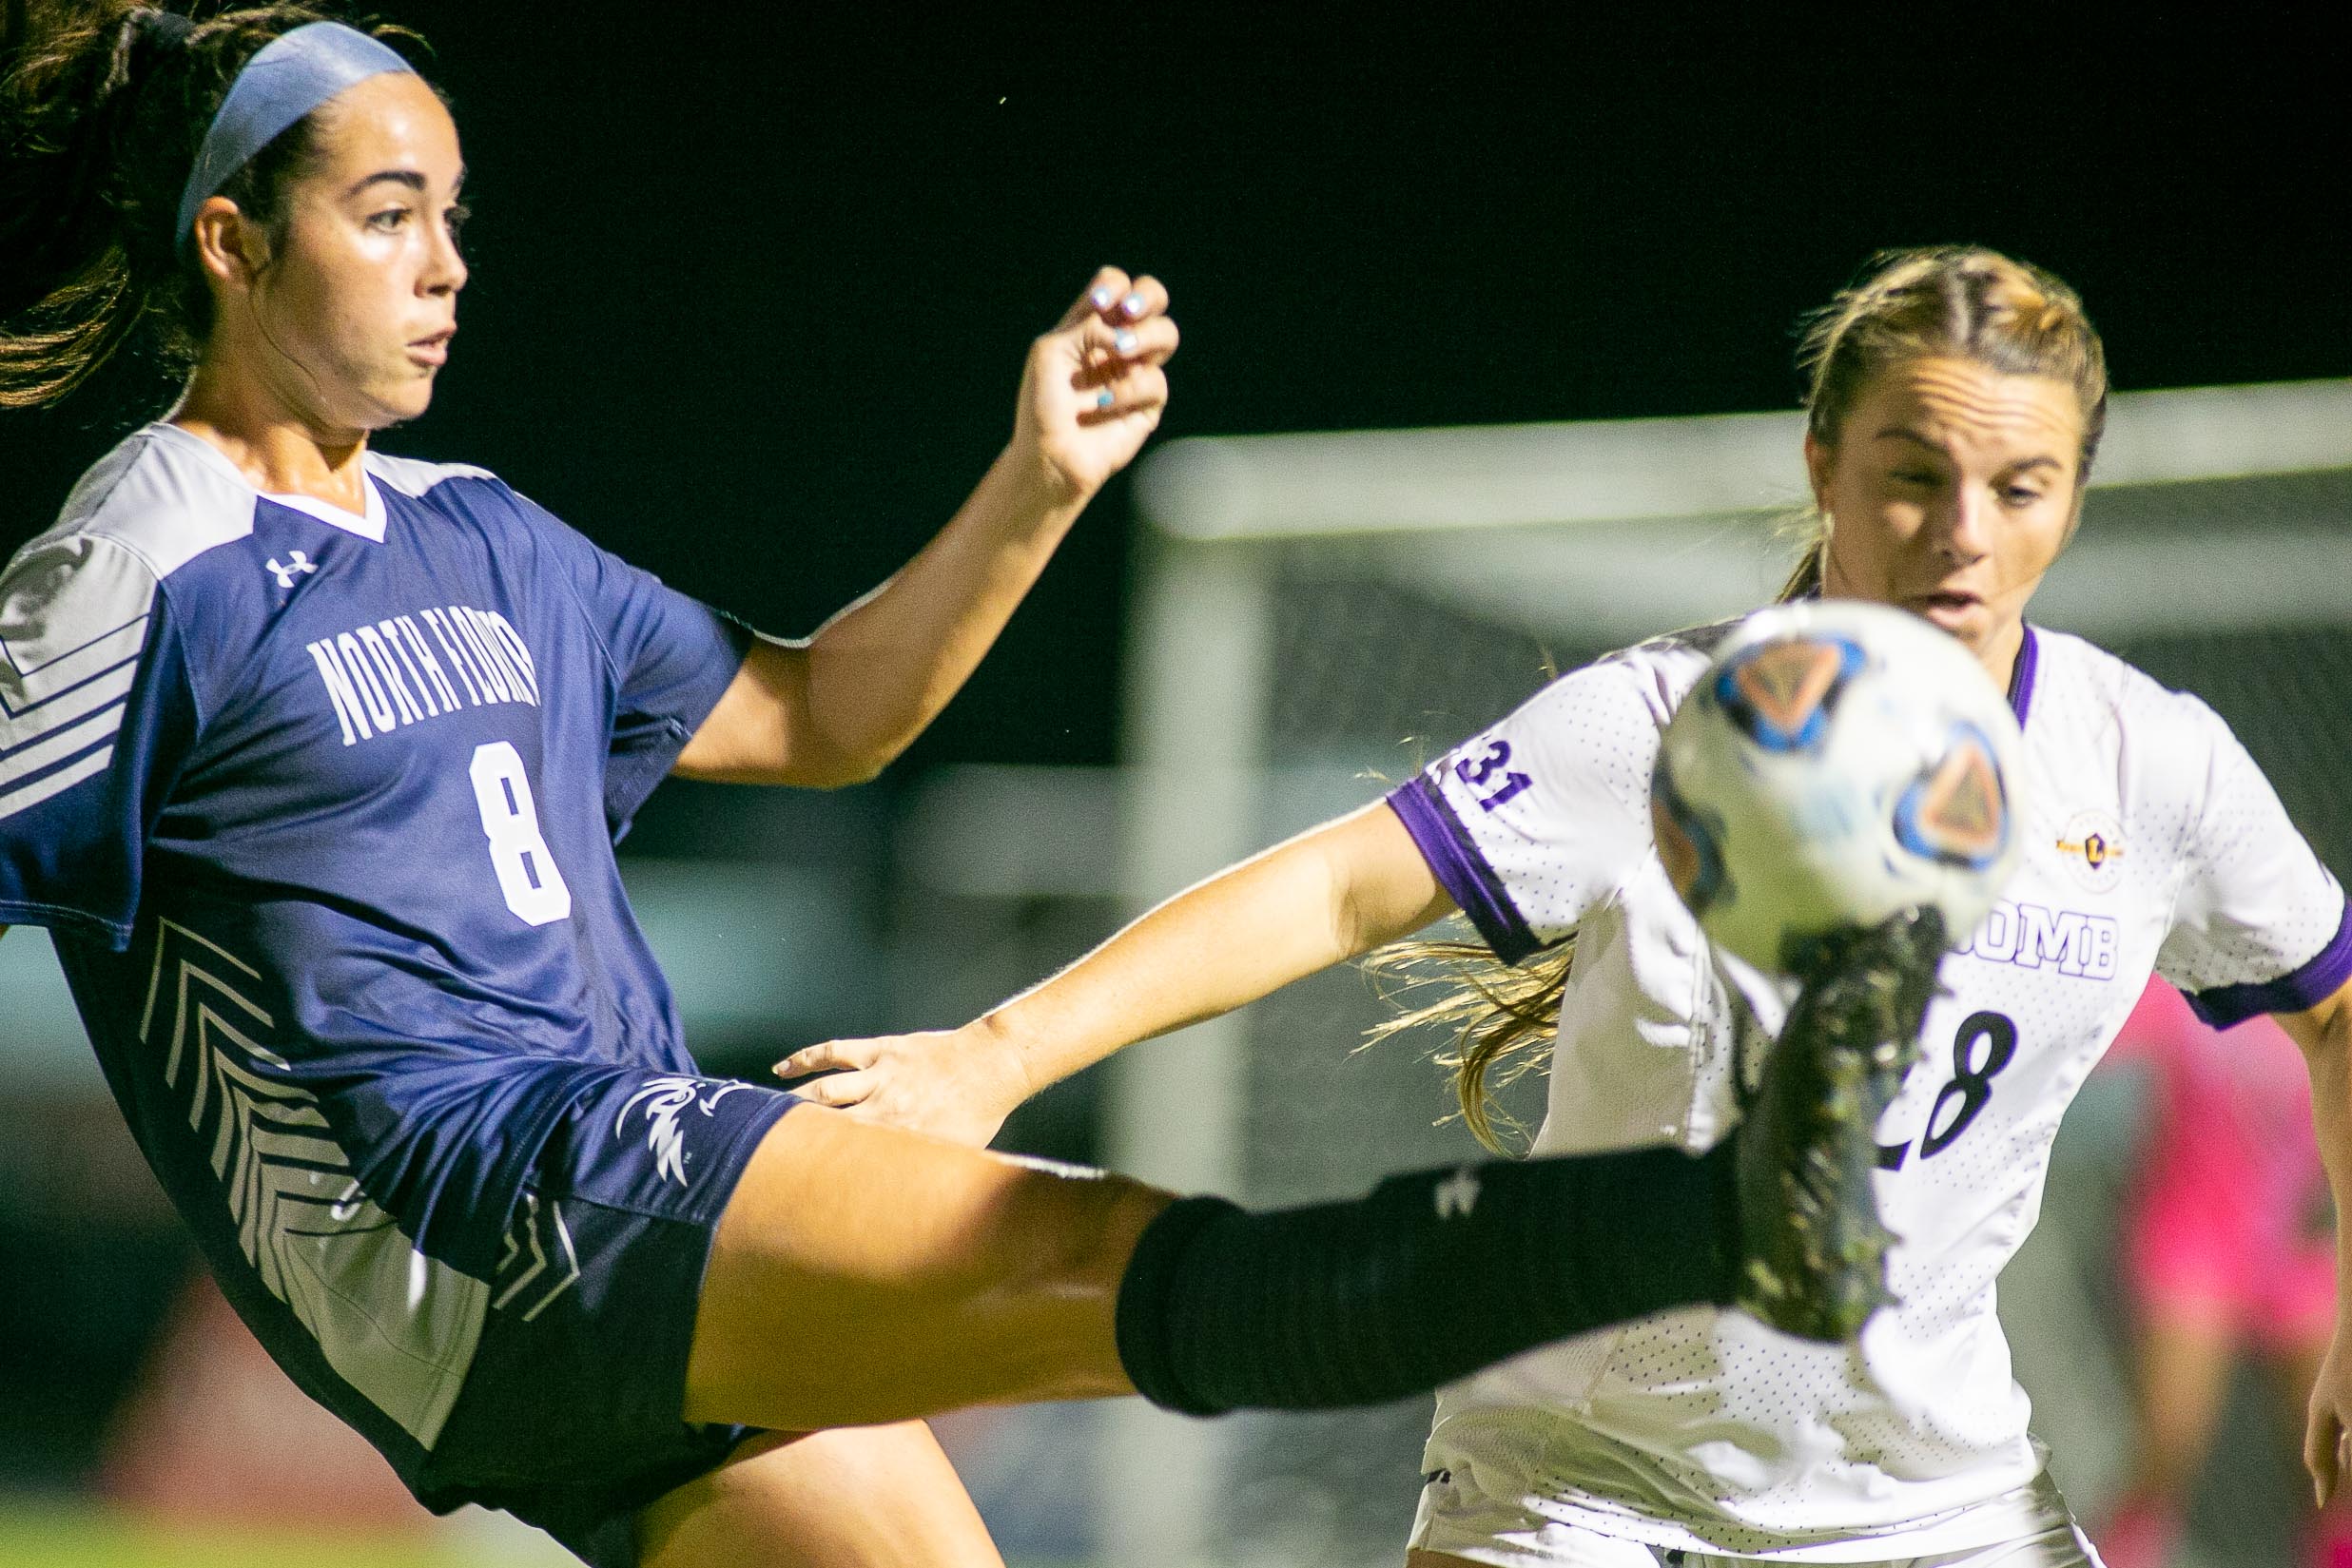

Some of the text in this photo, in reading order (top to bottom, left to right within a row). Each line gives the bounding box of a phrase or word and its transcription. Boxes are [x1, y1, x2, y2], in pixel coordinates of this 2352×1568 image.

[306, 614, 463, 746] NORTH
[469, 740, 572, 927] 8
[1455, 740, 1534, 814] 31
[1950, 899, 2119, 981] OMB
[1877, 1010, 2019, 1171] 8
